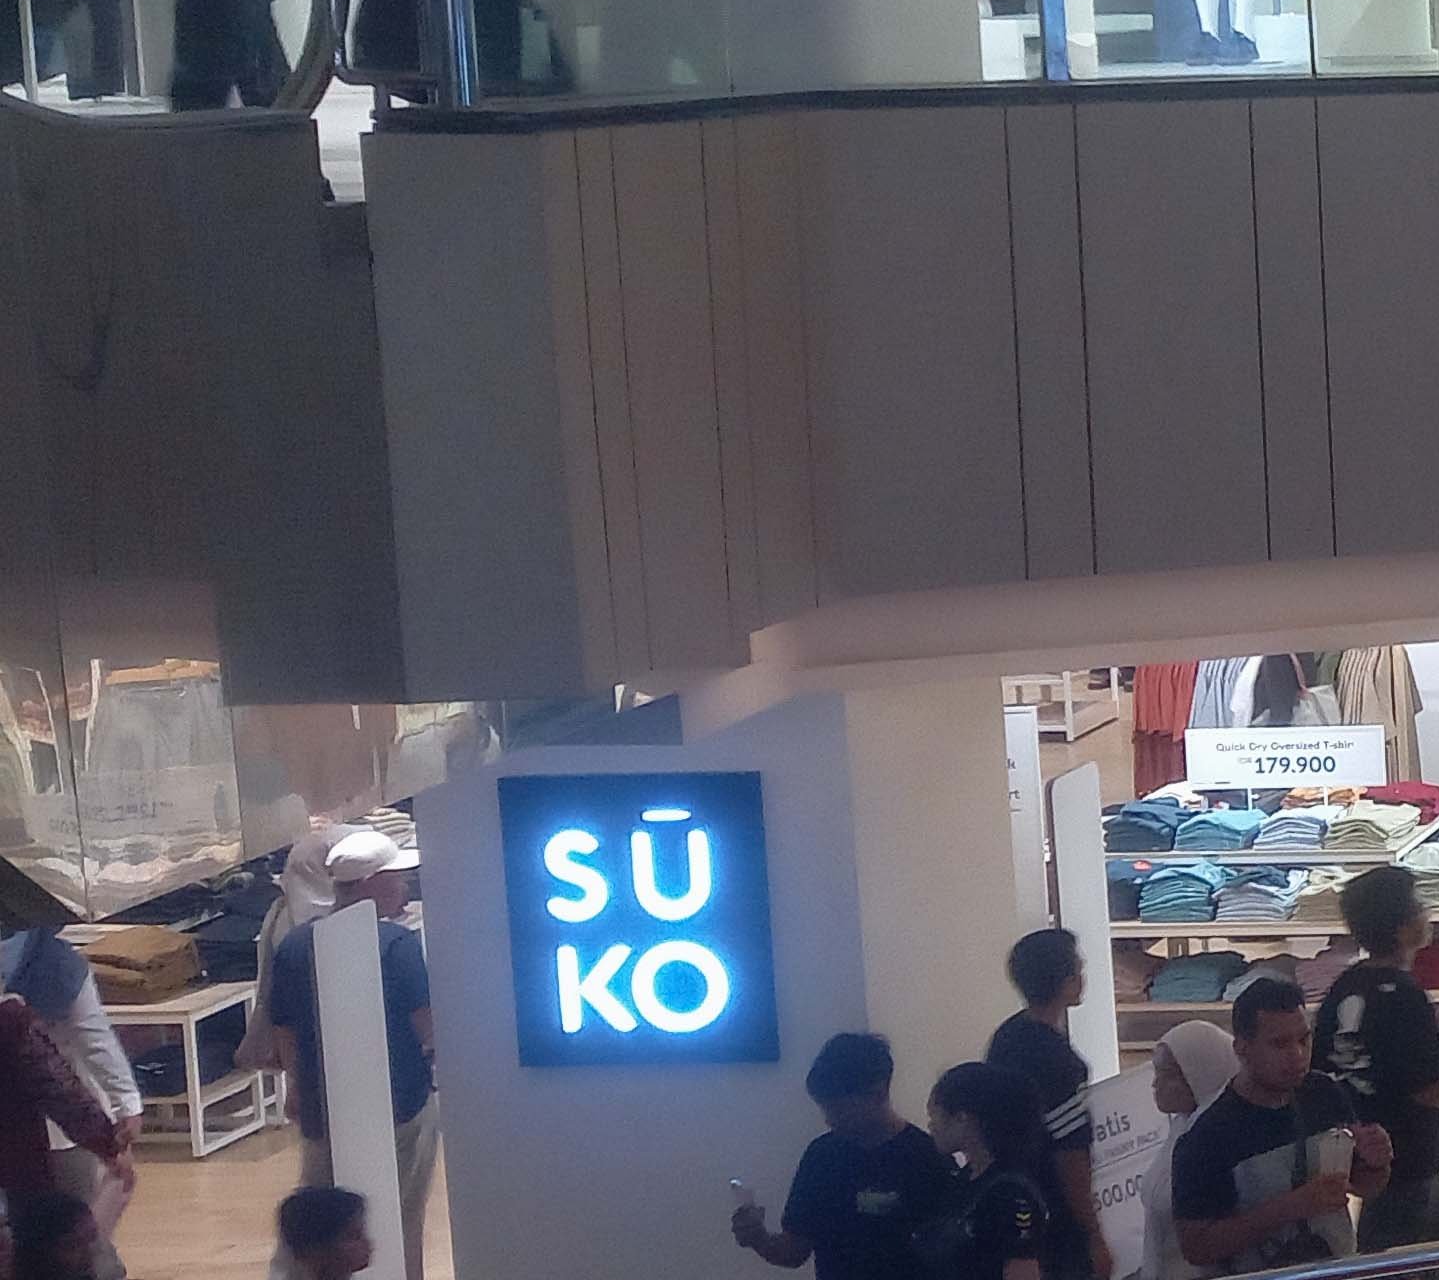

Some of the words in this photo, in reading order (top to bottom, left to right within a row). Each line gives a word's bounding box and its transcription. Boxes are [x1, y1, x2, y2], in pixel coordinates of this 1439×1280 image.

[1216, 742, 1245, 752] Quick
[1255, 756, 1336, 774] 179.900
[555, 941, 734, 1035] KO
[1096, 1111, 1131, 1142] atis
